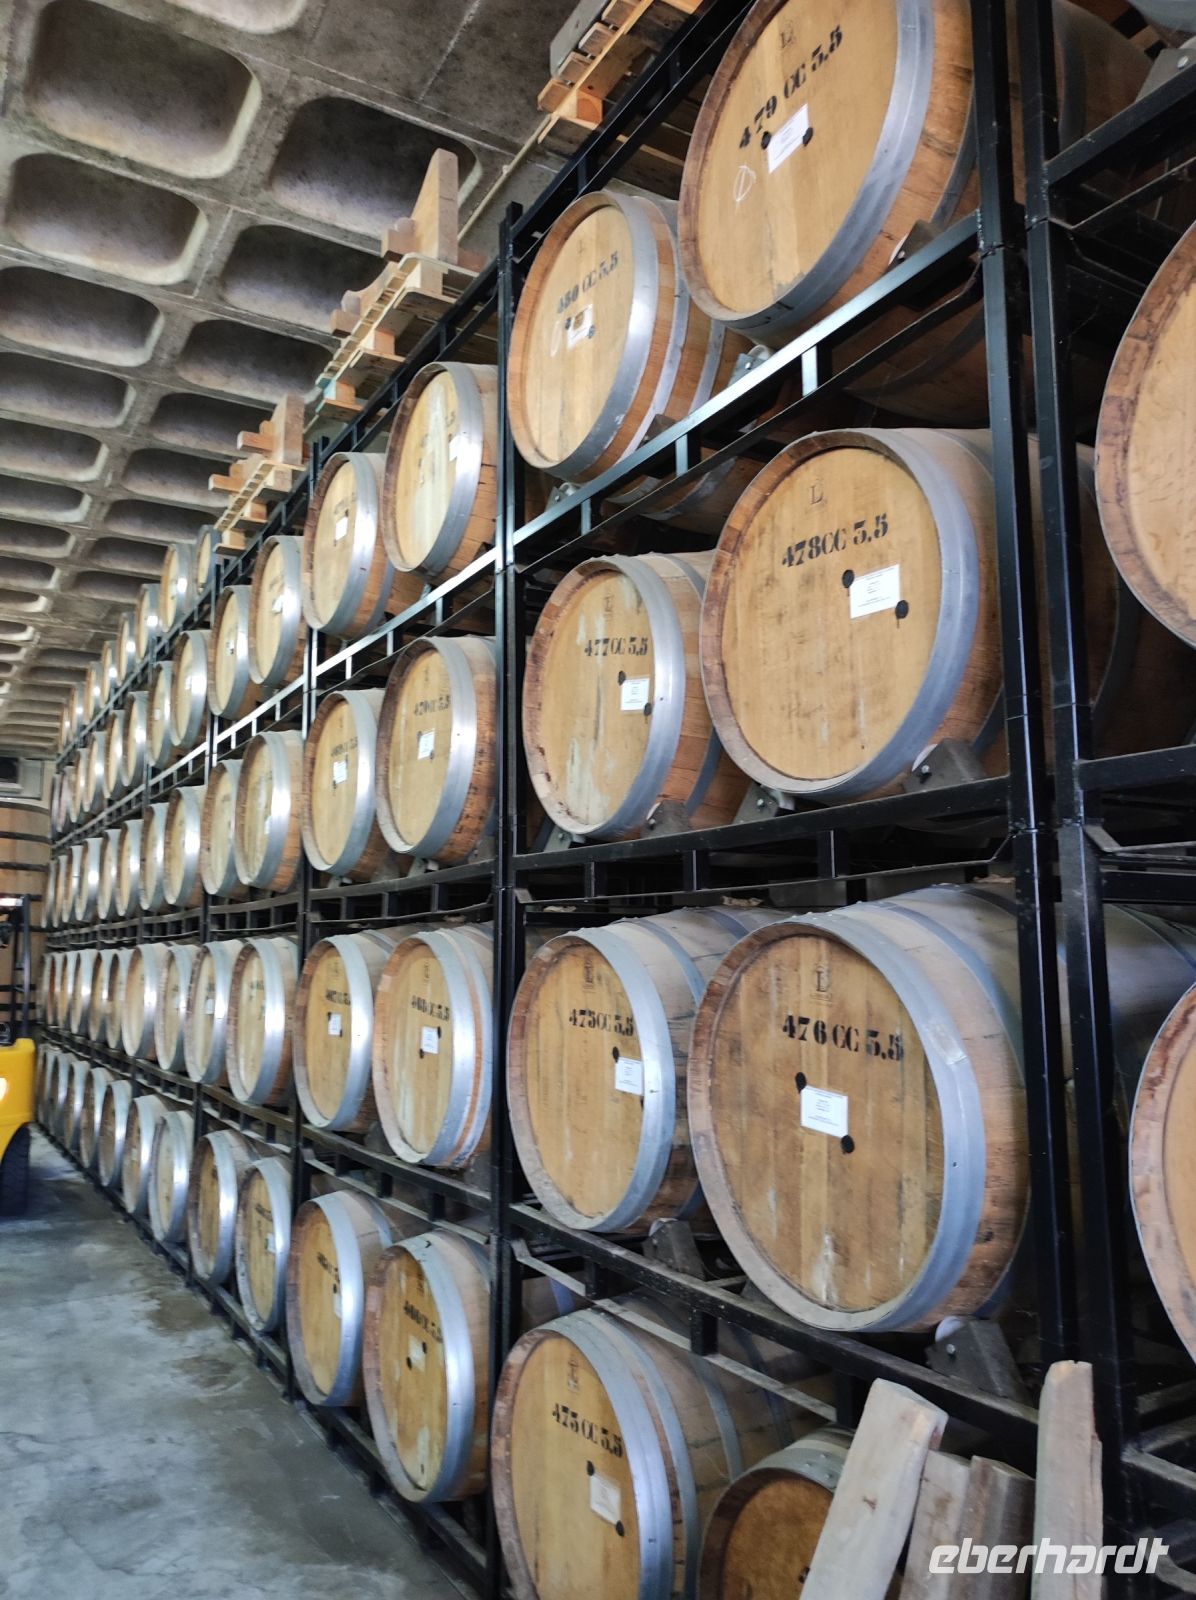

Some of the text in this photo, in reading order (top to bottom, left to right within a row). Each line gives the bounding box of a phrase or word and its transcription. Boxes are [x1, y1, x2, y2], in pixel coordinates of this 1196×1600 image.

[739, 95, 777, 149] 479
[782, 1015, 827, 1045] 476
[832, 1023, 860, 1053] CC
